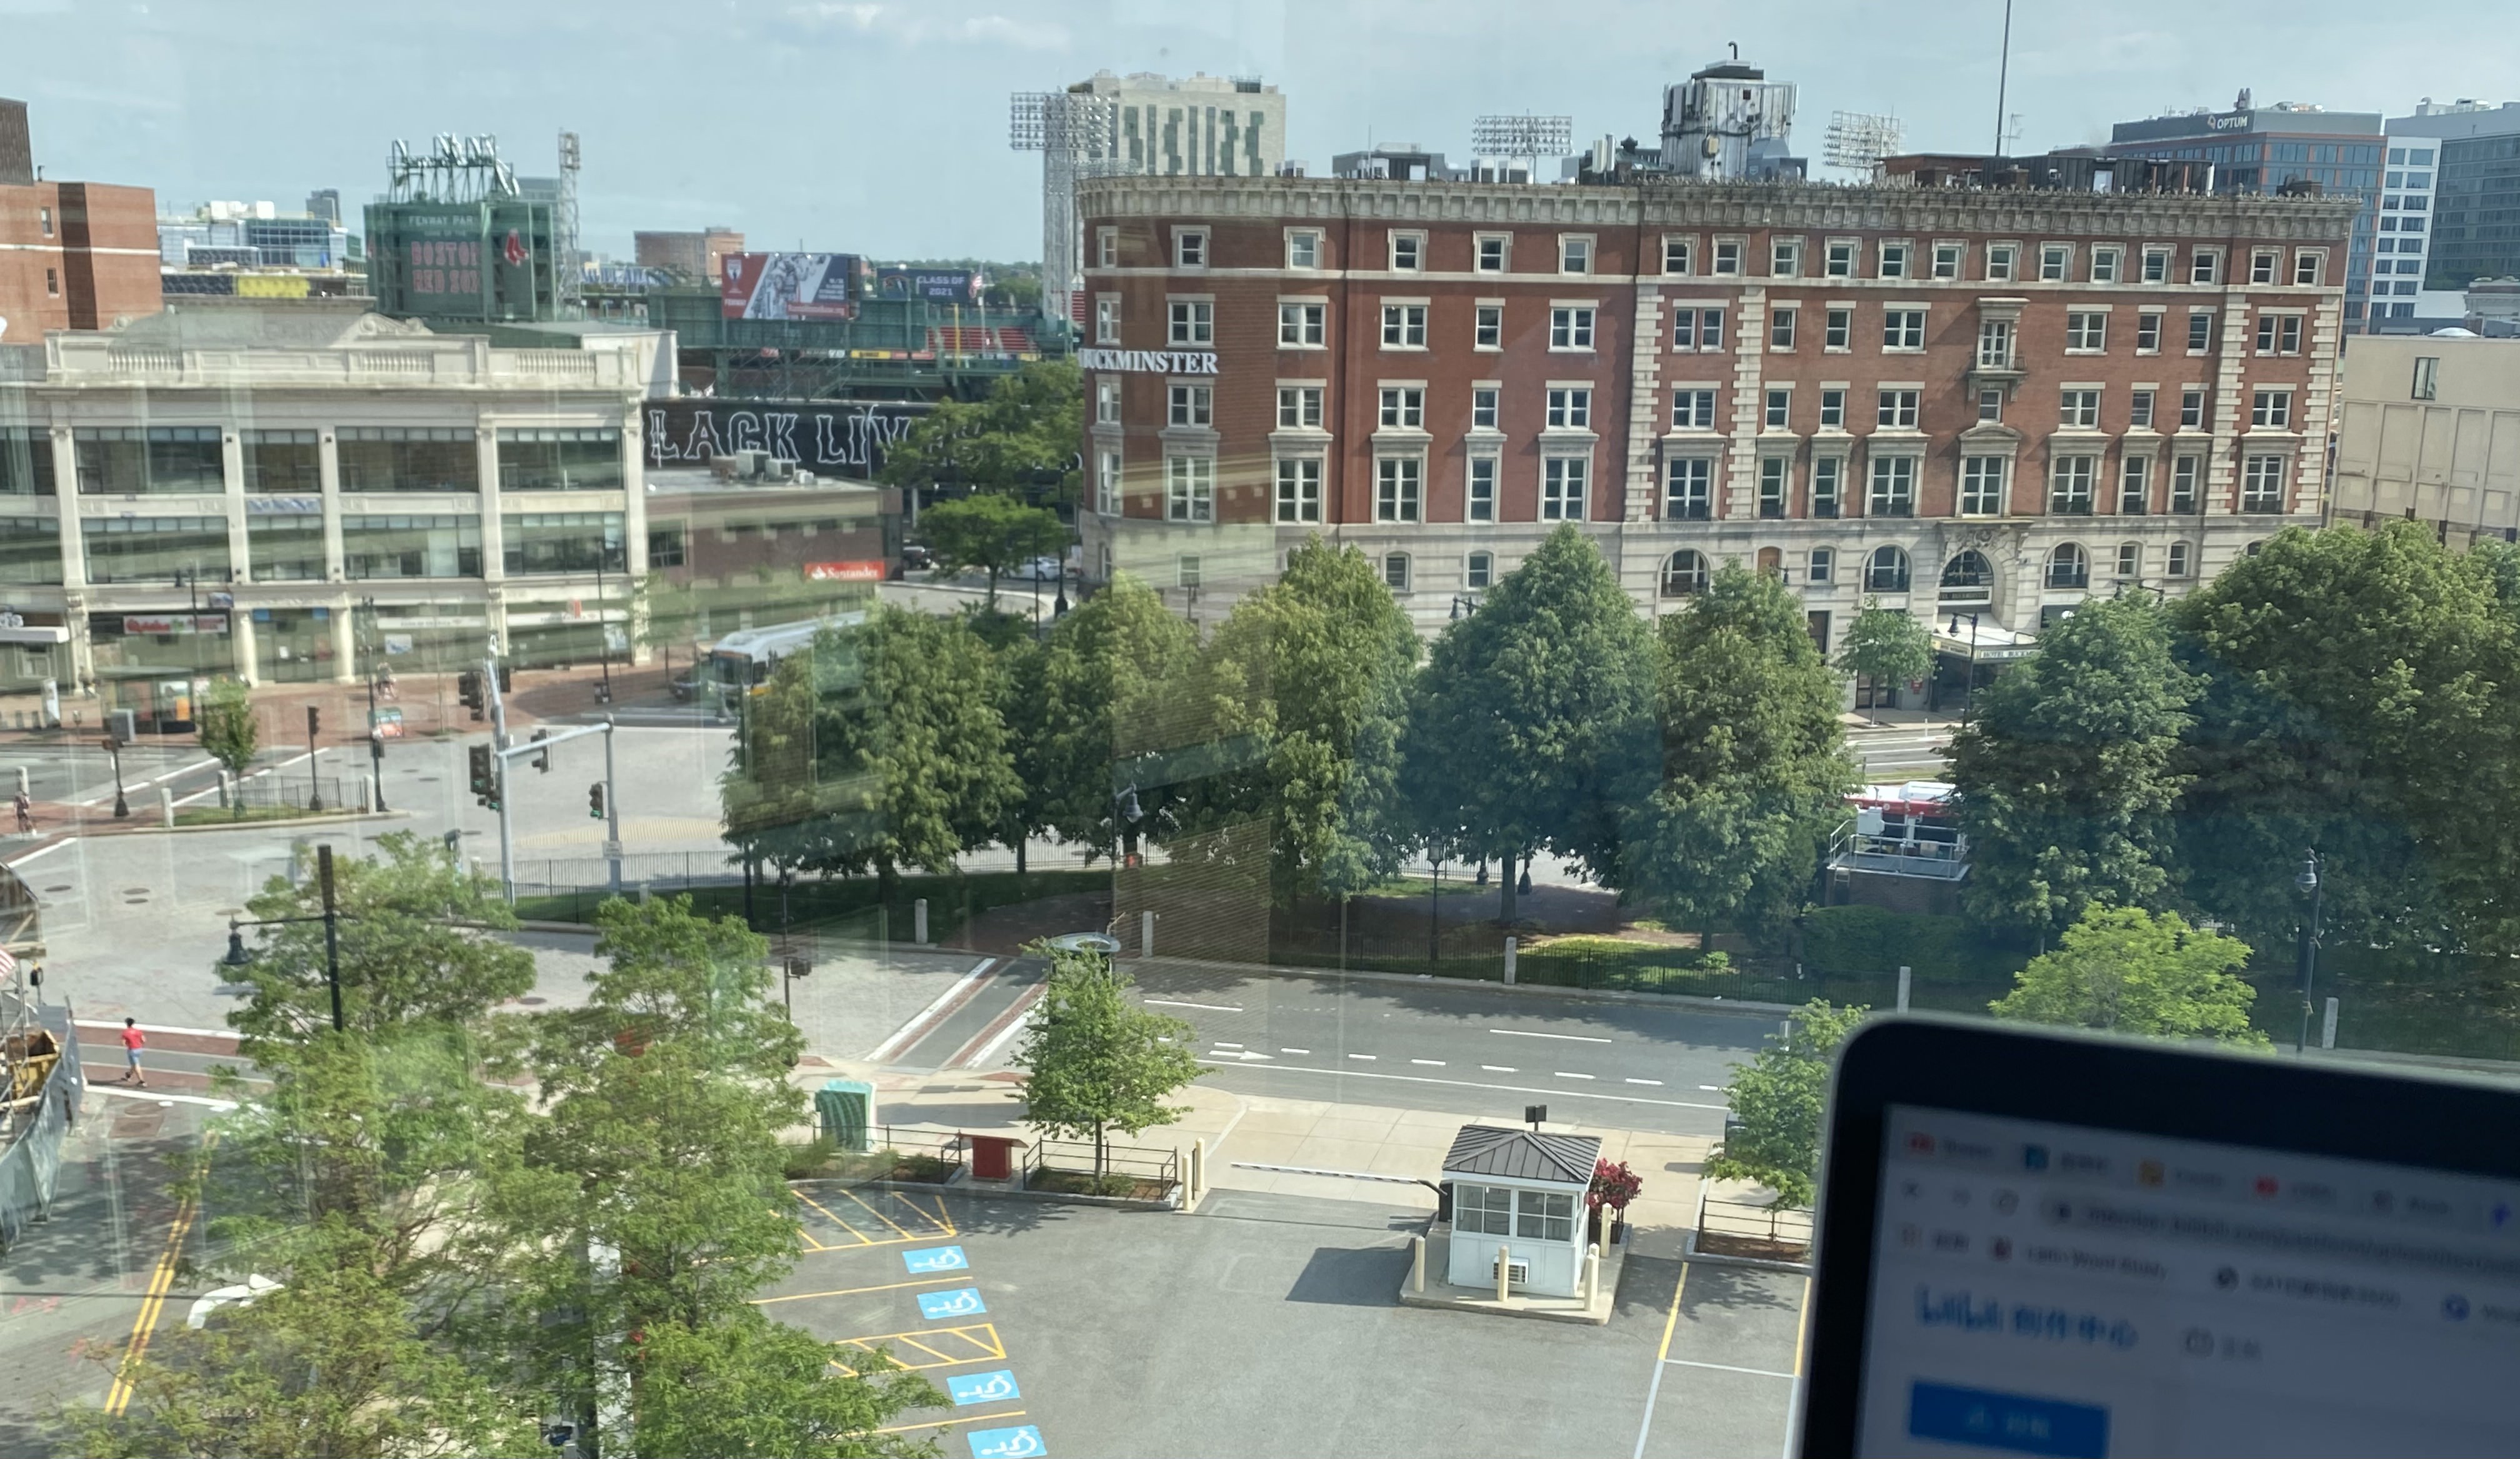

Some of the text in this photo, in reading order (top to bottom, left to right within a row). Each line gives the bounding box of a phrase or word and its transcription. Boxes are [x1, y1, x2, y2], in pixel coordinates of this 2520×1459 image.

[2217, 116, 2248, 129] OPTUM
[408, 215, 478, 226] FENWAY PAR
[412, 269, 446, 294] RED
[917, 276, 949, 284] CLASS
[929, 287, 953, 296] 2021
[642, 409, 801, 464] LACK
[827, 565, 878, 579] Santander
